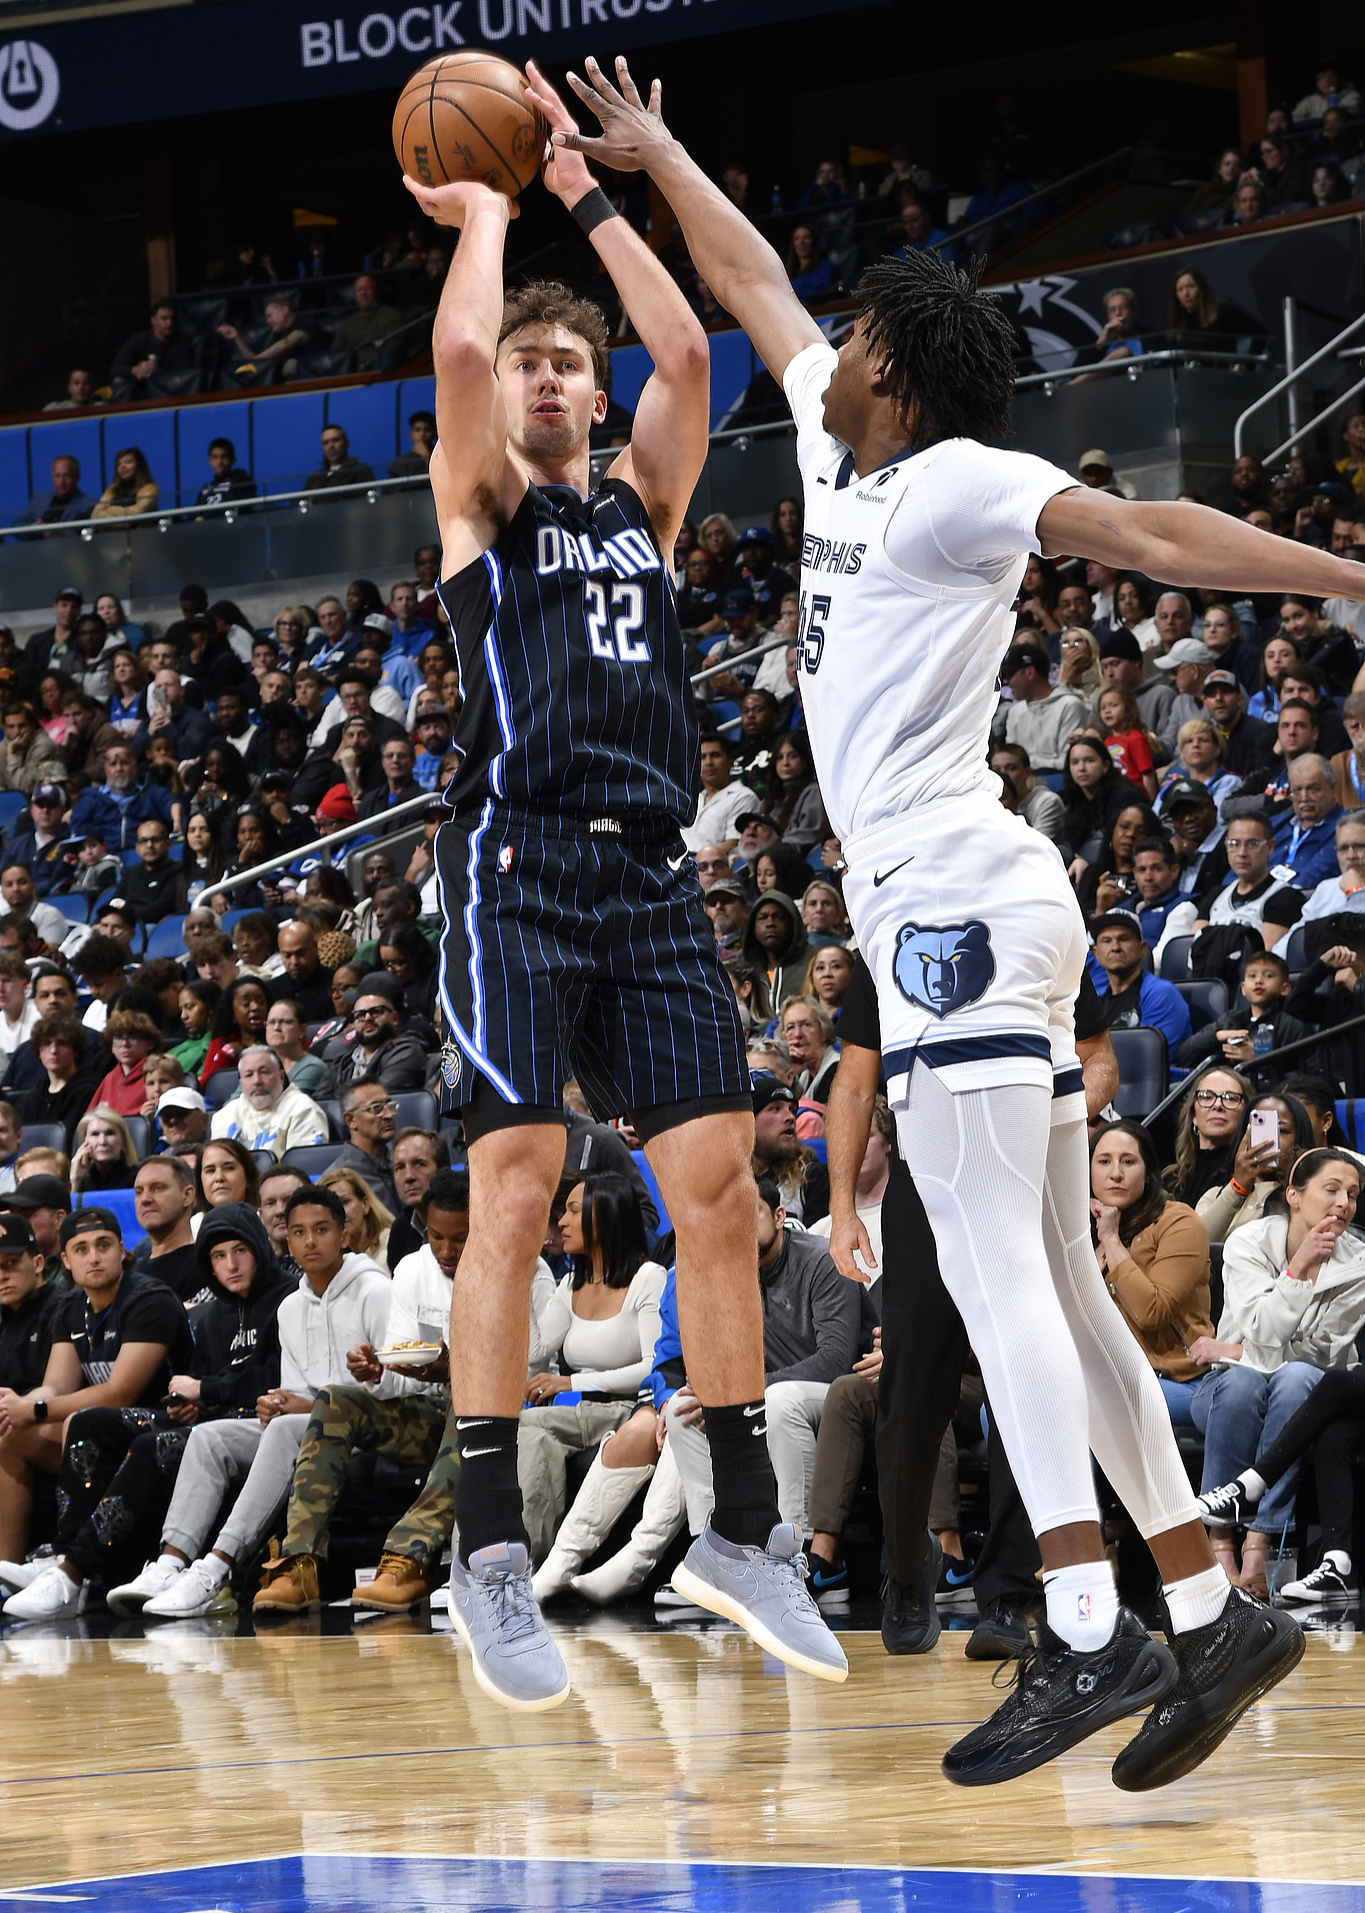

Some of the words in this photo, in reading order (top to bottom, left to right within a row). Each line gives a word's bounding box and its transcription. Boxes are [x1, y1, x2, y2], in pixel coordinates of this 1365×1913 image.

[301, 2, 465, 67] BLOCK
[584, 578, 652, 662] 22
[589, 817, 622, 834] MAGIC
